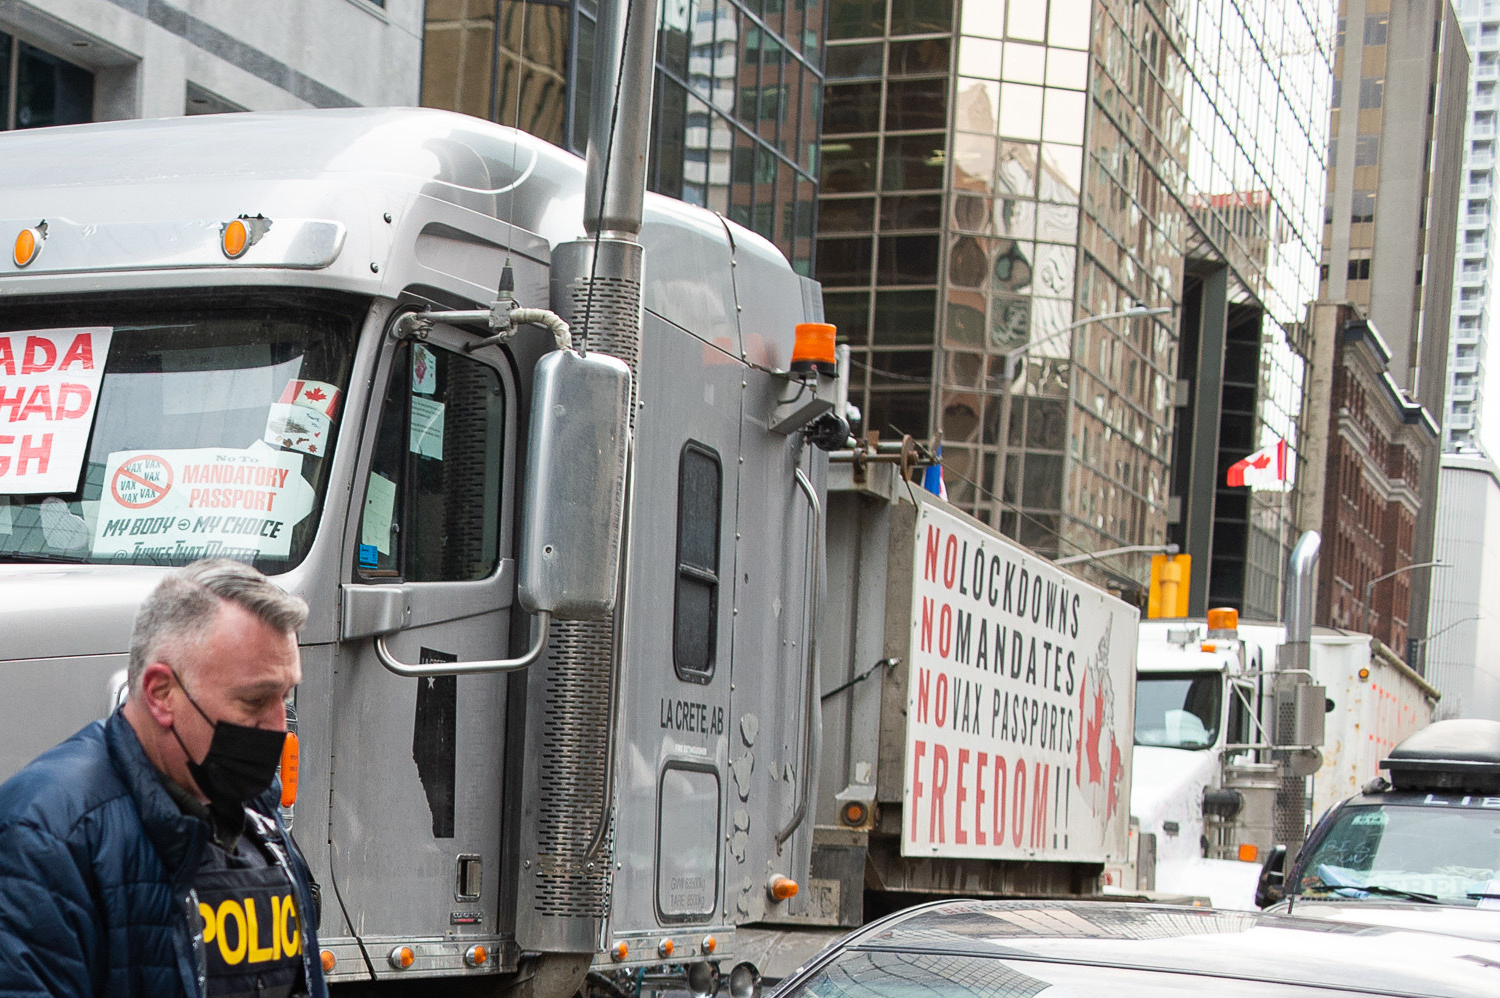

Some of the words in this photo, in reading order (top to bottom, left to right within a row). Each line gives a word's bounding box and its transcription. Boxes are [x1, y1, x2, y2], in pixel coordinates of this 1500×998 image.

[120, 480, 137, 491] VAX
[143, 471, 160, 482] VAX
[182, 465, 289, 489] MANDATORY
[189, 488, 276, 512] PASSPORT
[102, 519, 130, 538] MY
[129, 516, 176, 535] BODY
[192, 516, 220, 534] MY
[220, 516, 284, 539] CHOICE
[923, 523, 958, 590] NO
[959, 541, 1081, 640] LOCKDOWNS
[920, 596, 952, 658] NO
[954, 609, 1076, 696] MANDATES
[660, 698, 673, 729] LA
[675, 700, 709, 739] CRETE,
[710, 705, 724, 735] AB
[916, 667, 949, 728] NO
[953, 677, 982, 736] VAX
[991, 688, 1074, 755] PASSPORTS
[911, 740, 1070, 850] FREEDOM!!
[198, 894, 301, 966] POLIC
